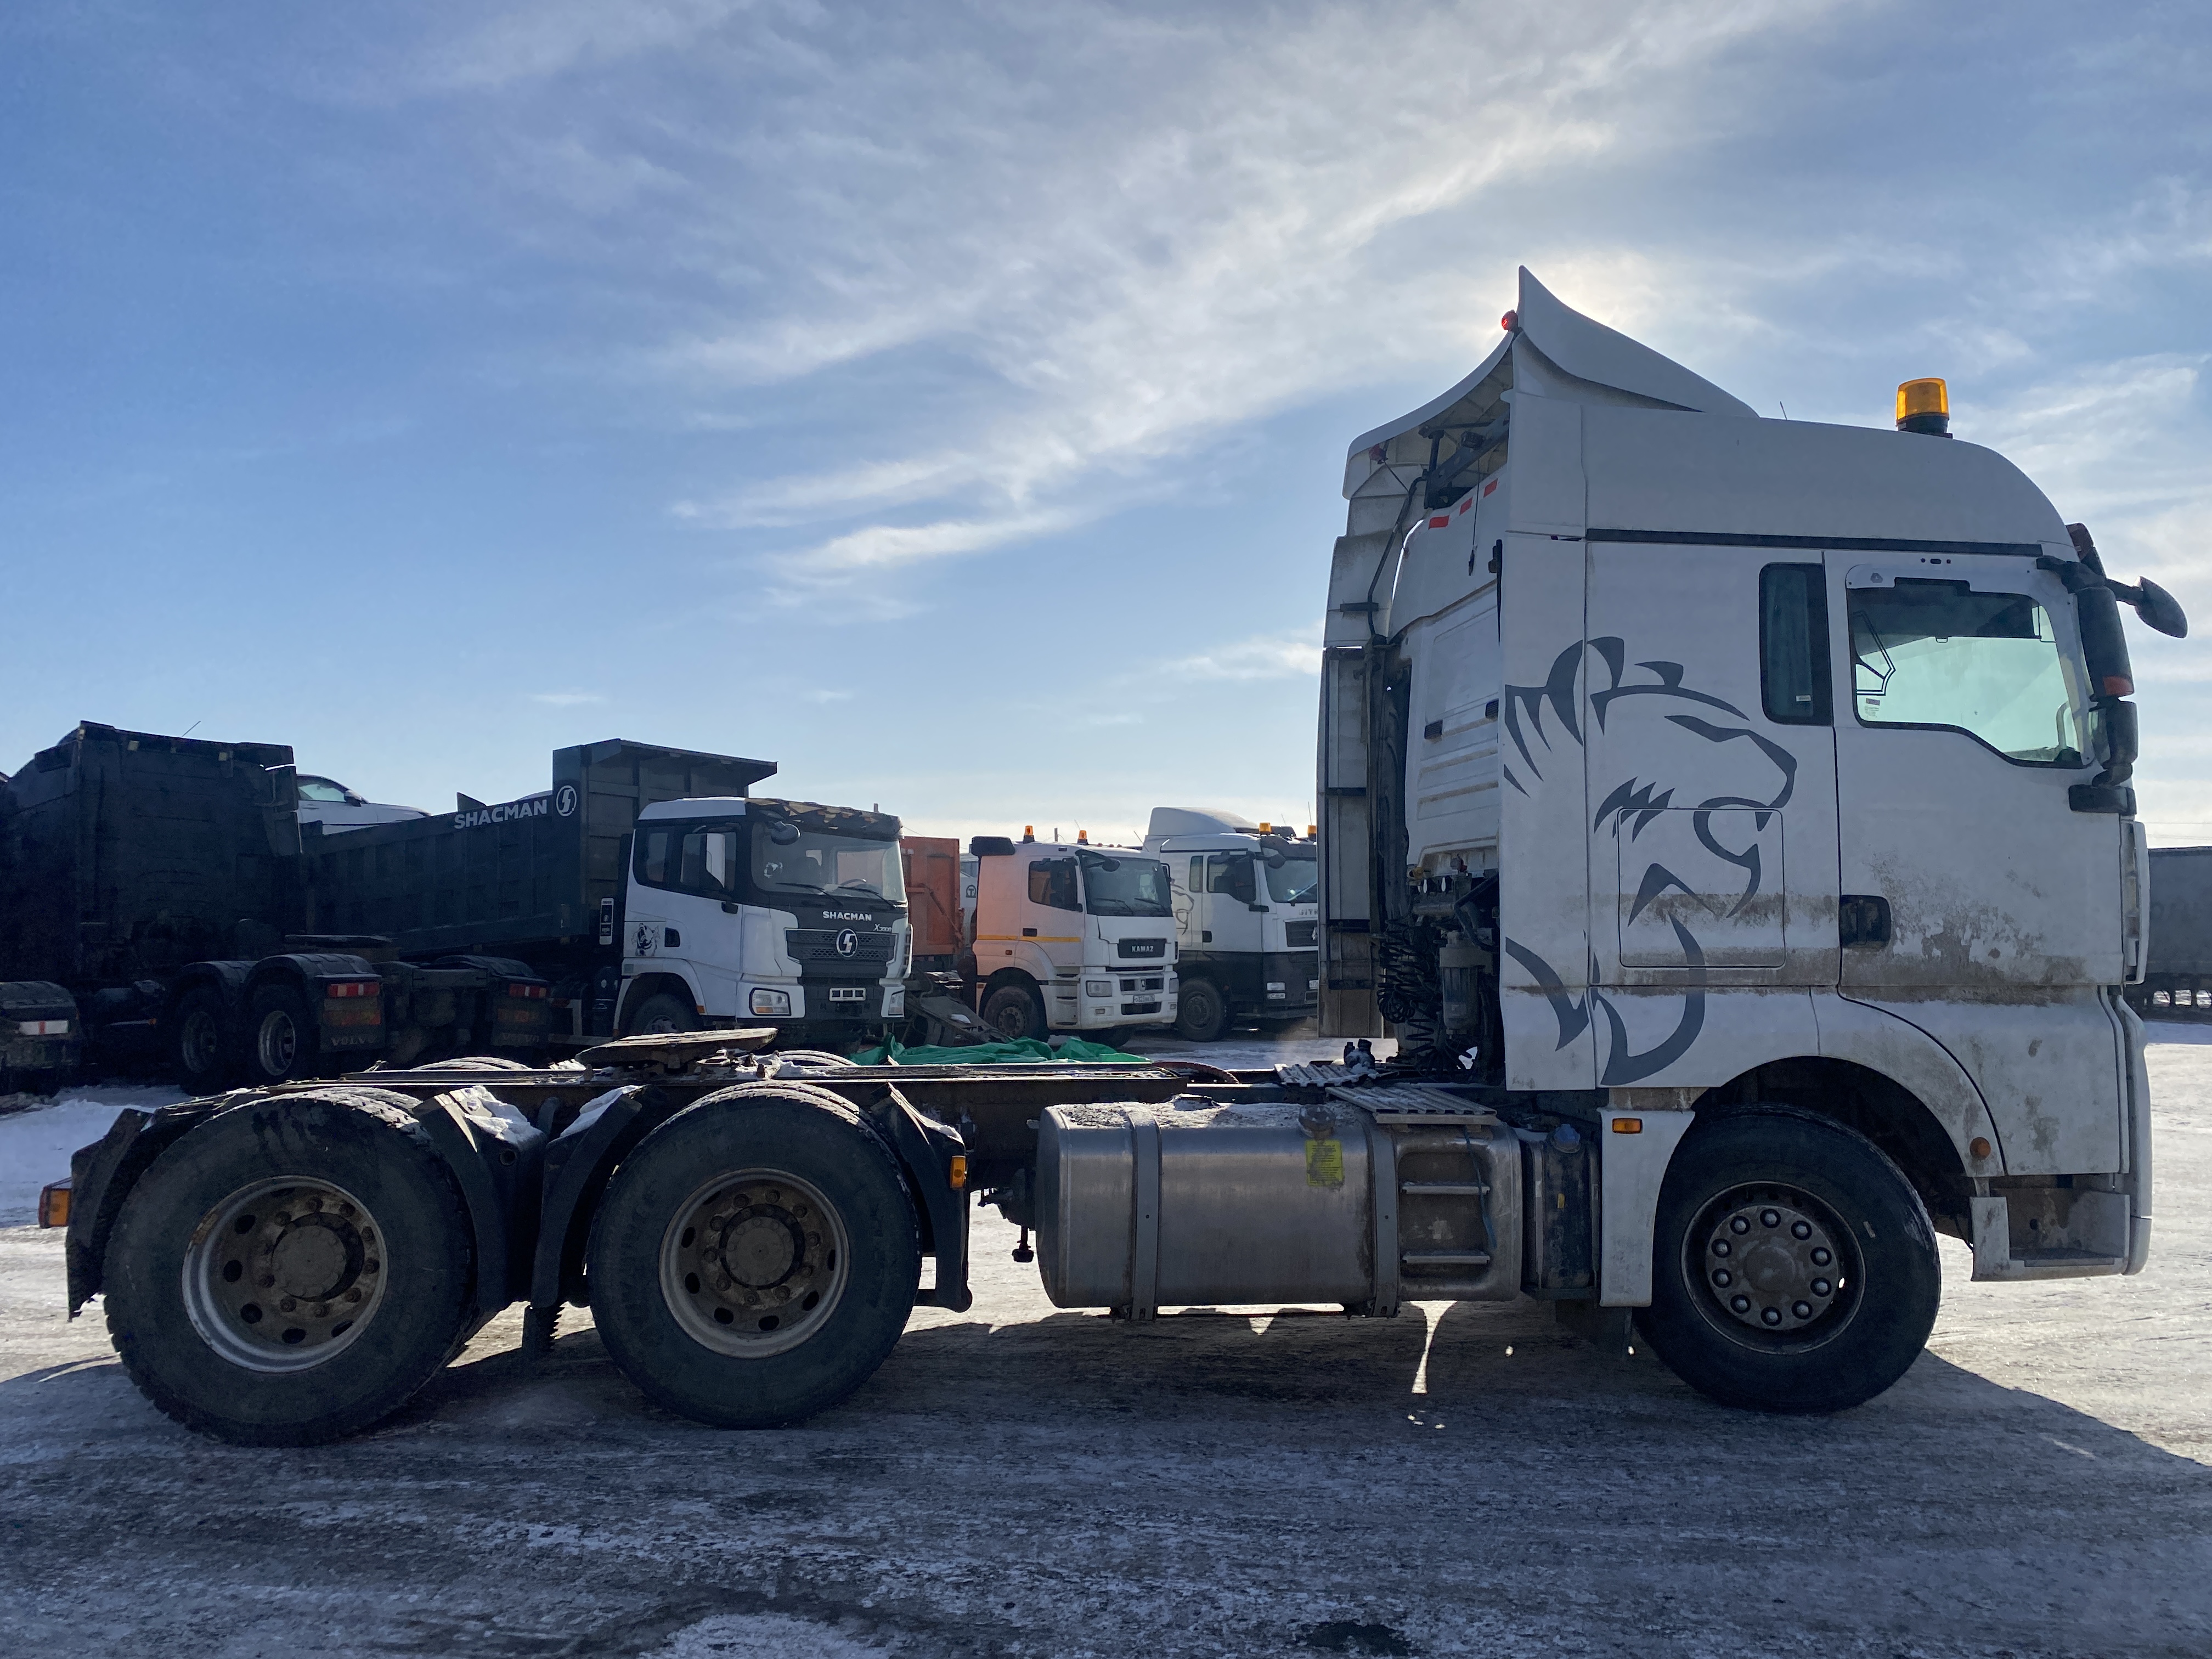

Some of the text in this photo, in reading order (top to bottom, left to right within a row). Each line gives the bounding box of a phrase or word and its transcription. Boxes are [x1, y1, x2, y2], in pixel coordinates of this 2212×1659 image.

[454, 799, 548, 830] SHACMAN
[822, 911, 872, 921] SHACMAN
[873, 923, 892, 932] X3000
[330, 1035, 376, 1046] VOLVO
